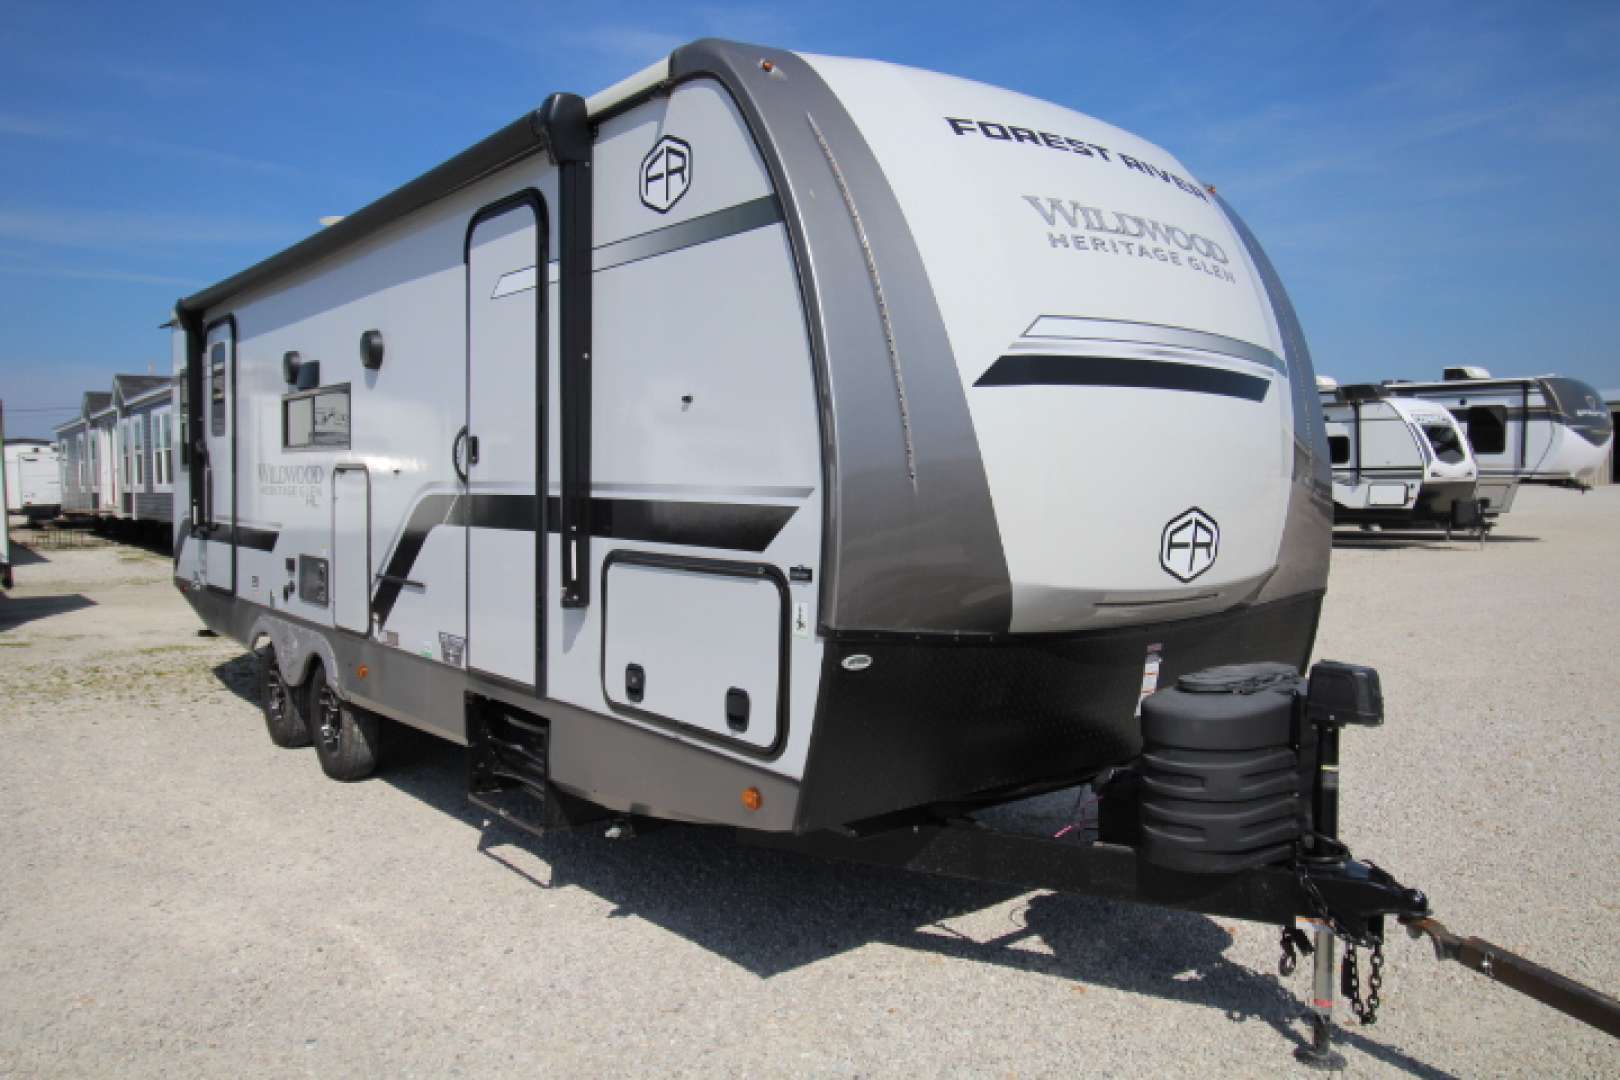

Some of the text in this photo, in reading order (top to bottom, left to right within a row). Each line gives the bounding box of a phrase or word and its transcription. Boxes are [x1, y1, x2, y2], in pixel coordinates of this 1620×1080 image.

[943, 116, 1210, 203] FOREST RIVER
[1021, 194, 1230, 265] WILDWOOD
[1046, 231, 1236, 284] HERITAGE GLEN
[258, 463, 324, 485] WILDWOOD
